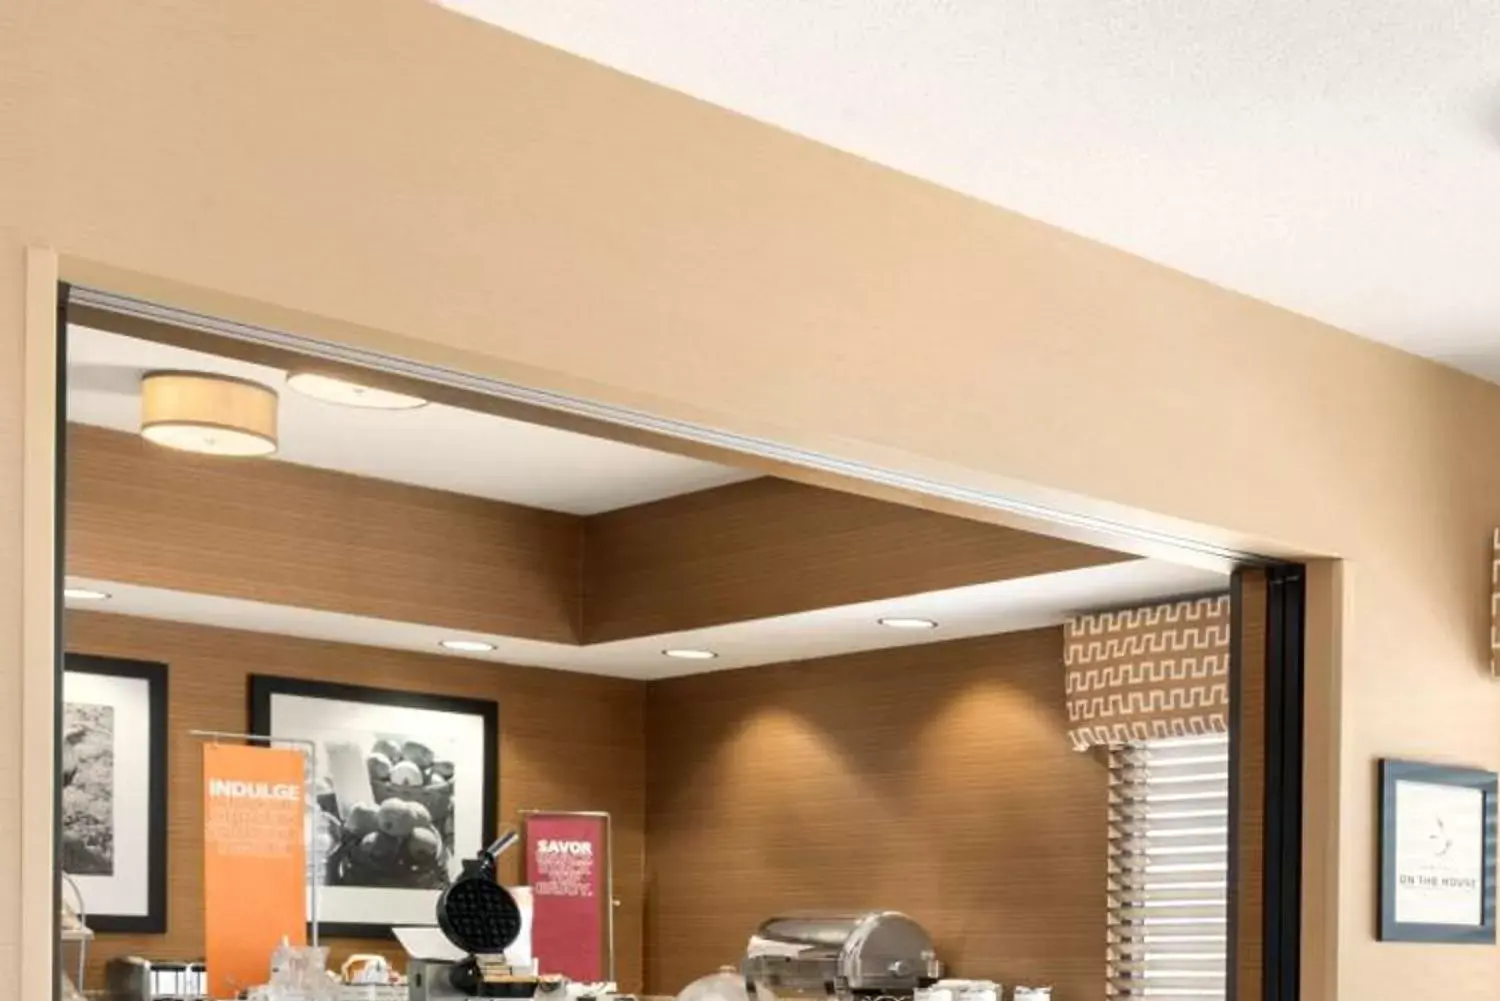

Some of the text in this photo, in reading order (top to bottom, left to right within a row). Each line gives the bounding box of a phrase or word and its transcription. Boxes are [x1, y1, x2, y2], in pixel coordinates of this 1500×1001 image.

[209, 778, 300, 800] INDULGE
[537, 840, 592, 855] SAVOR
[1400, 875, 1414, 886] ON
[1418, 875, 1438, 887] THE
